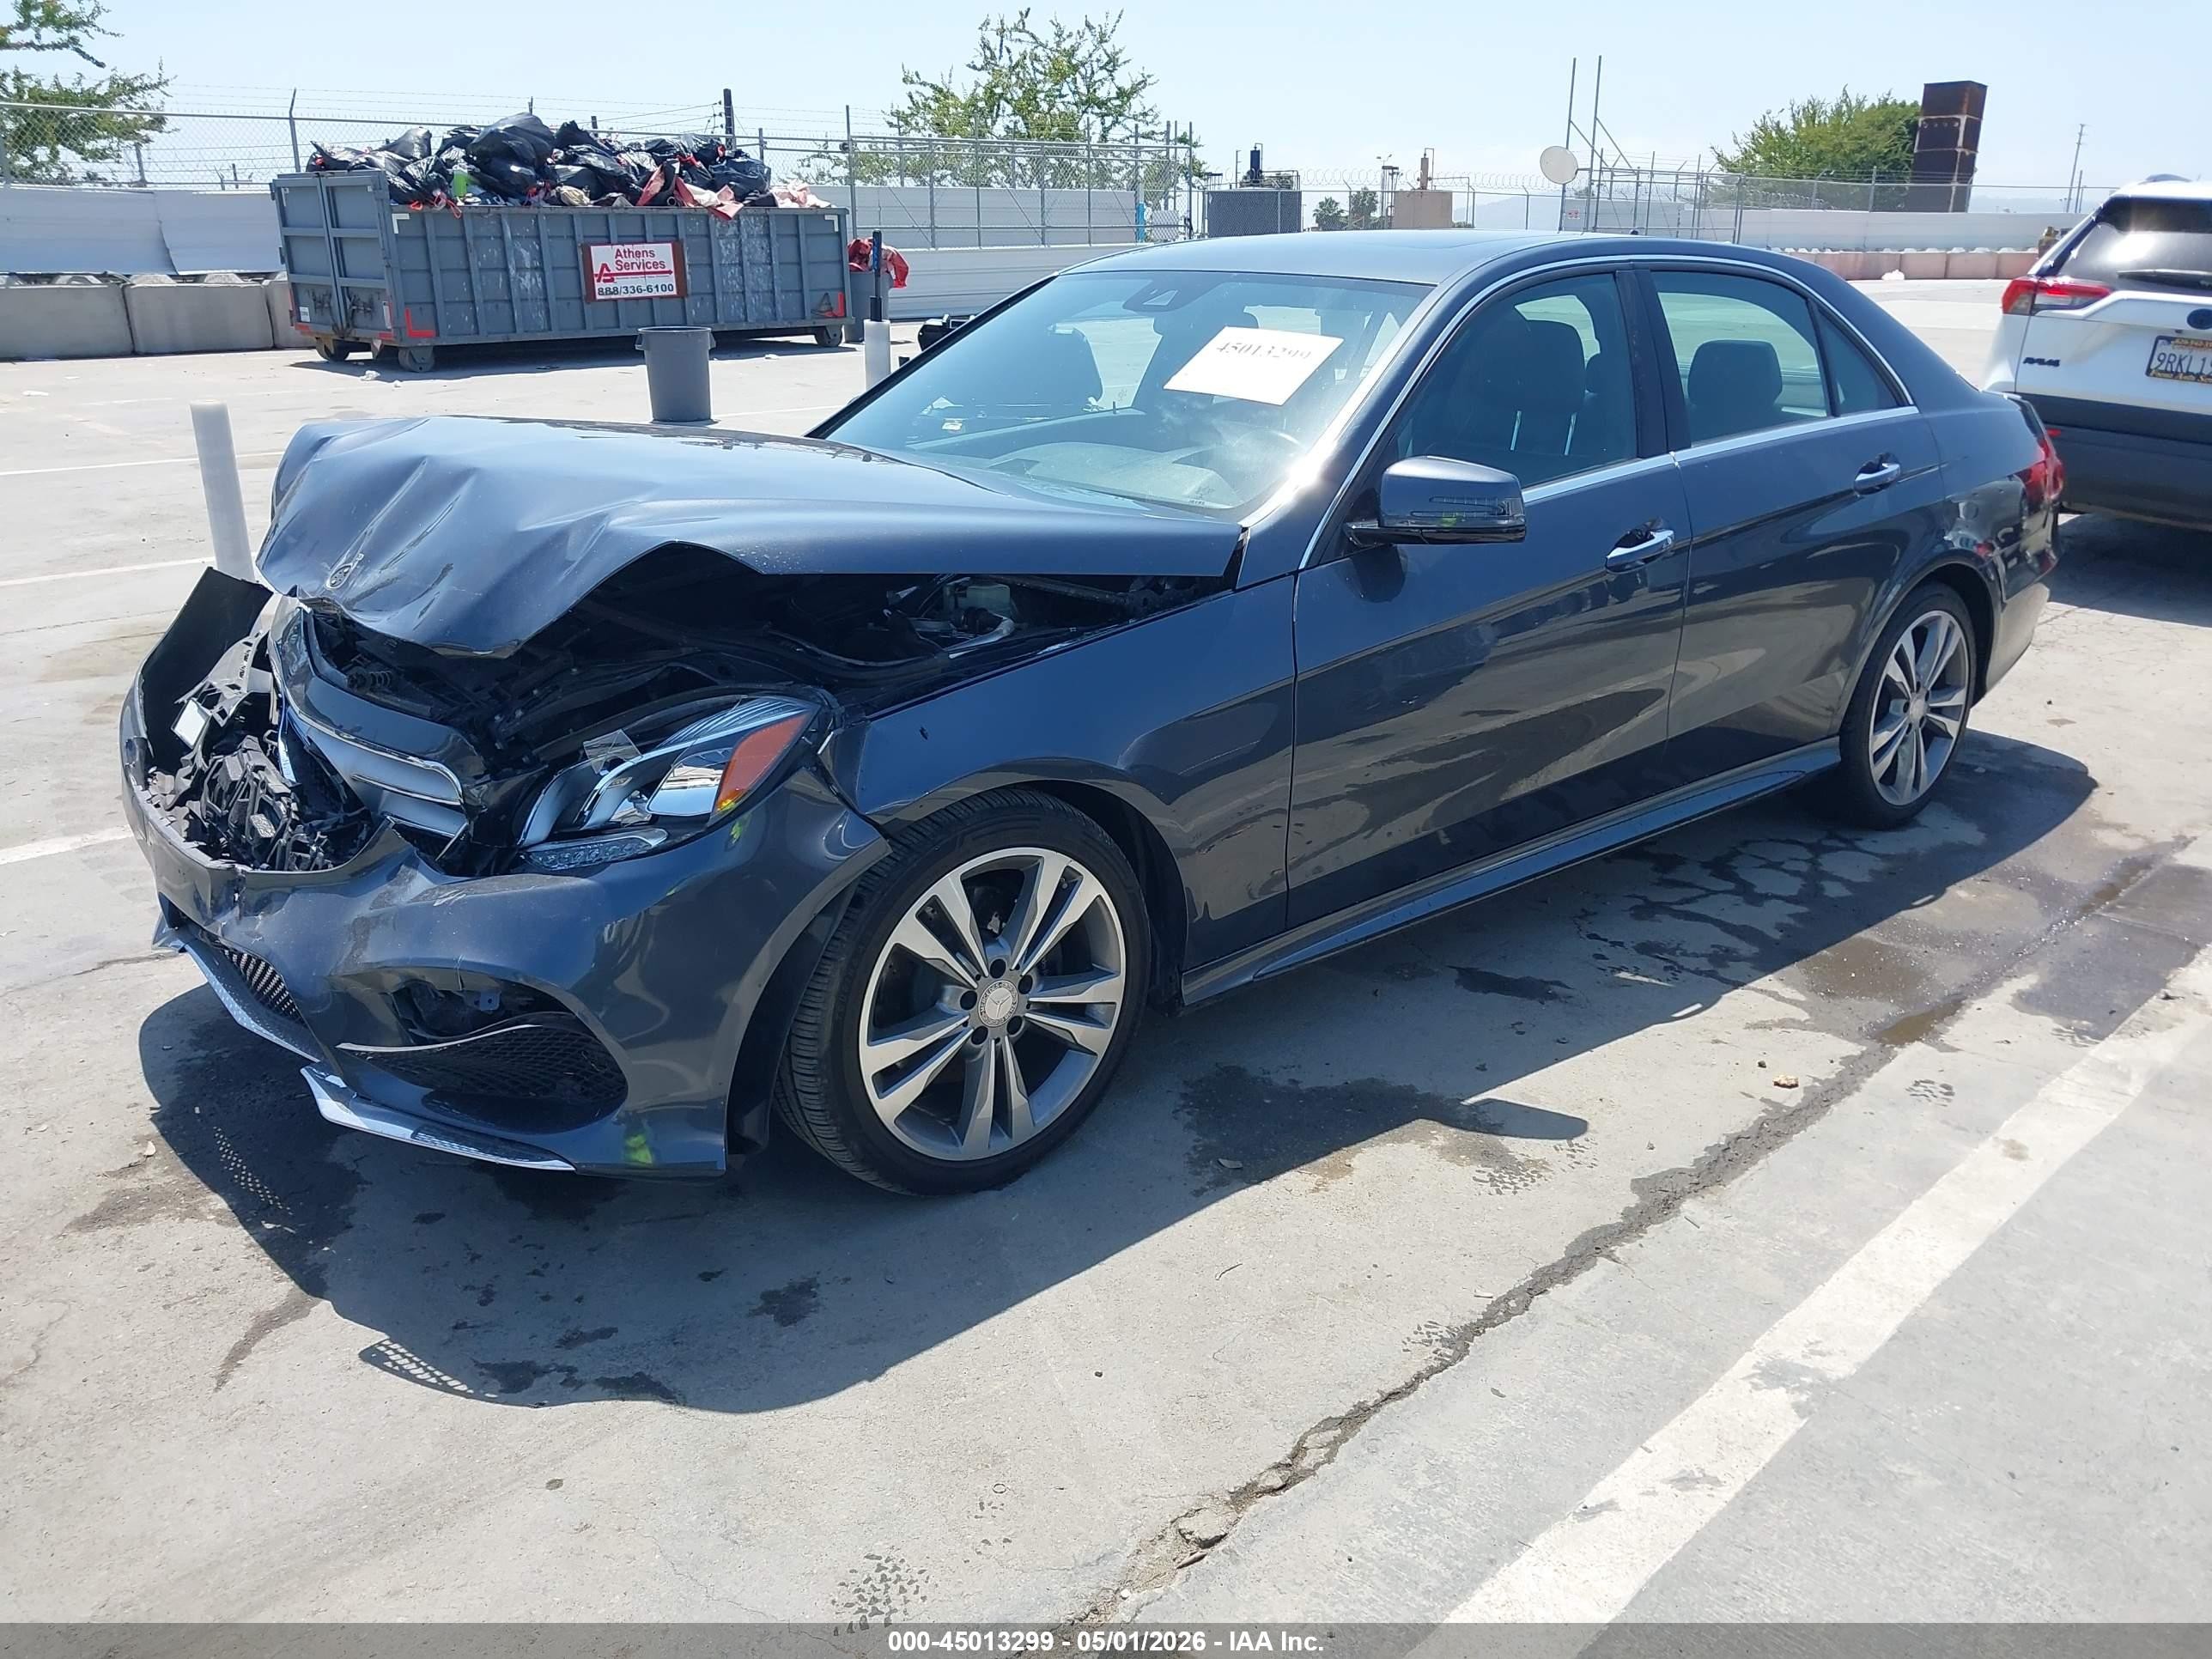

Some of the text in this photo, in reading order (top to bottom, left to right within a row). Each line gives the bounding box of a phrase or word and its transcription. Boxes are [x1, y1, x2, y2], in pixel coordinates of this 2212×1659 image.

[615, 248, 655, 259] Athens
[615, 259, 666, 270] Services
[598, 283, 674, 296] 888/336-6100
